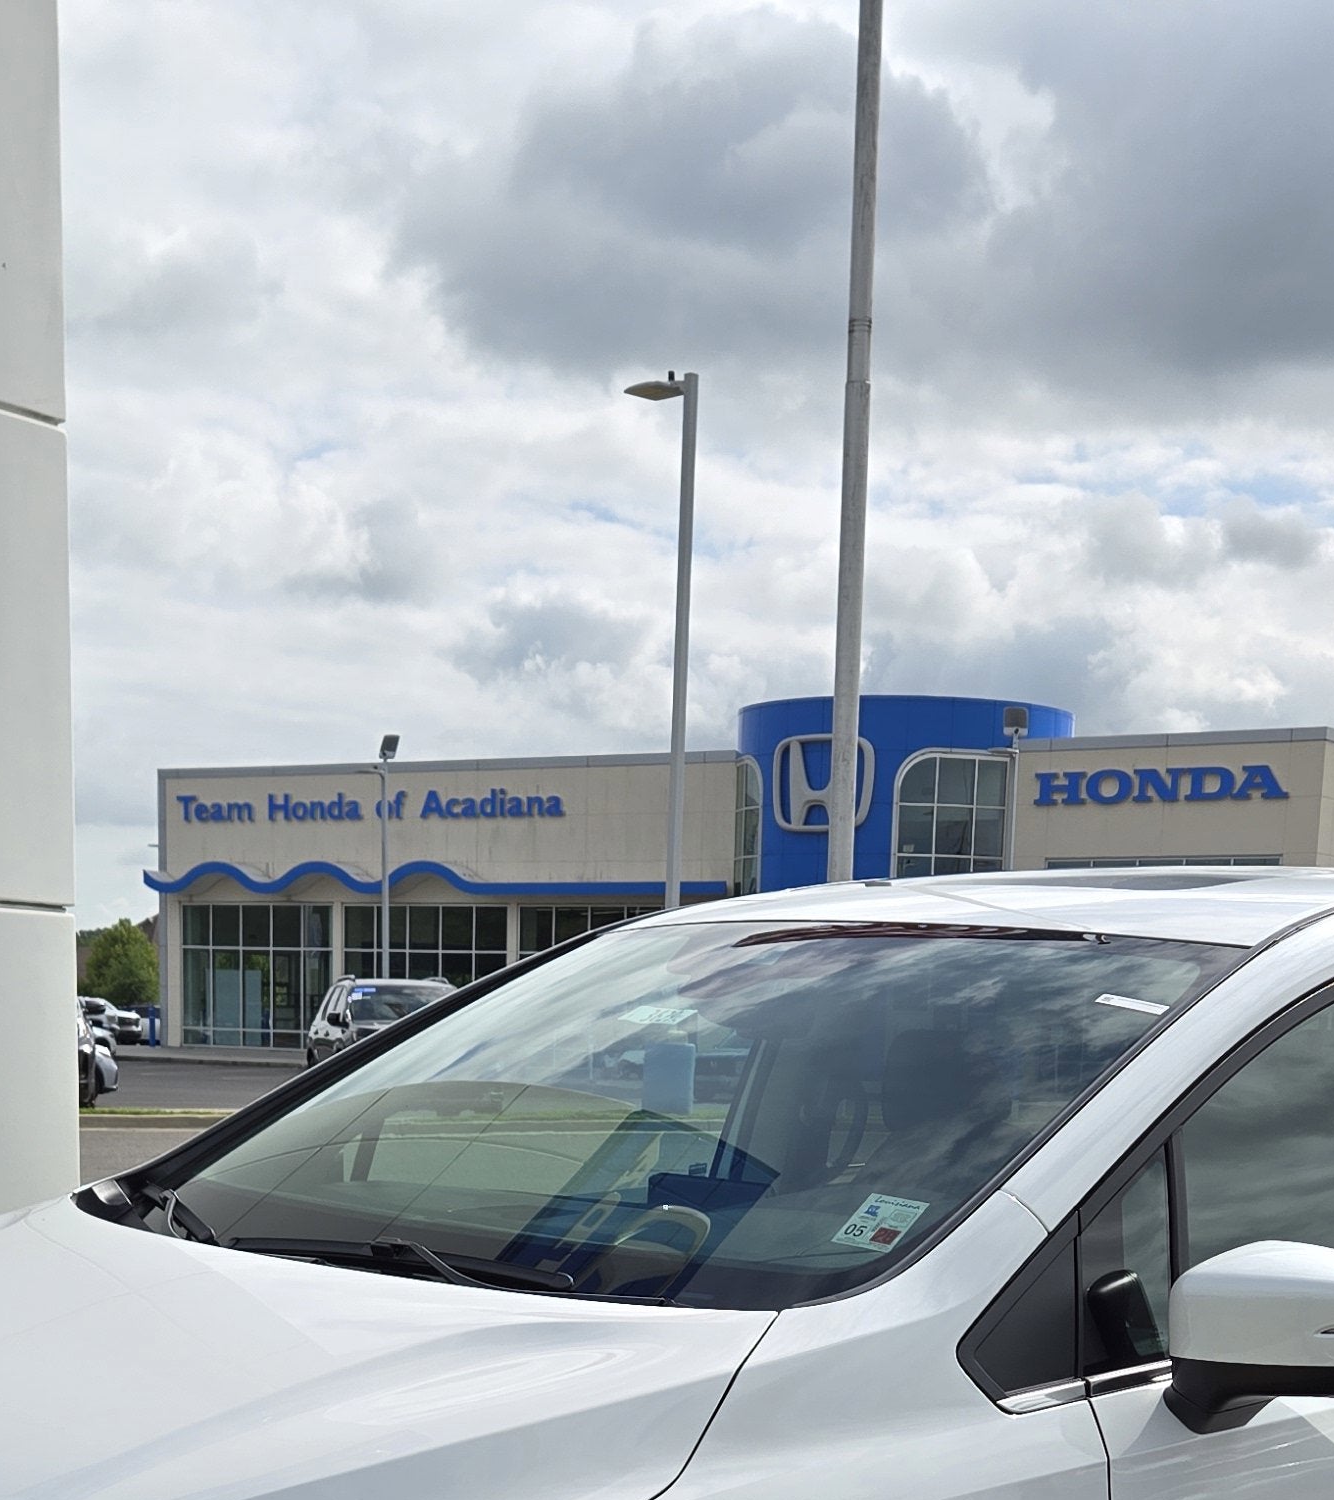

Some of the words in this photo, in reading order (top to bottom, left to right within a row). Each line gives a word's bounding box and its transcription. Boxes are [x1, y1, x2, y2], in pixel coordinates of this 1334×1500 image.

[1033, 764, 1290, 806] HONDA
[176, 794, 255, 823] Team
[267, 792, 364, 822] Honda
[375, 790, 408, 820] of
[419, 788, 566, 820] Acadiana
[844, 1223, 868, 1237] 05
